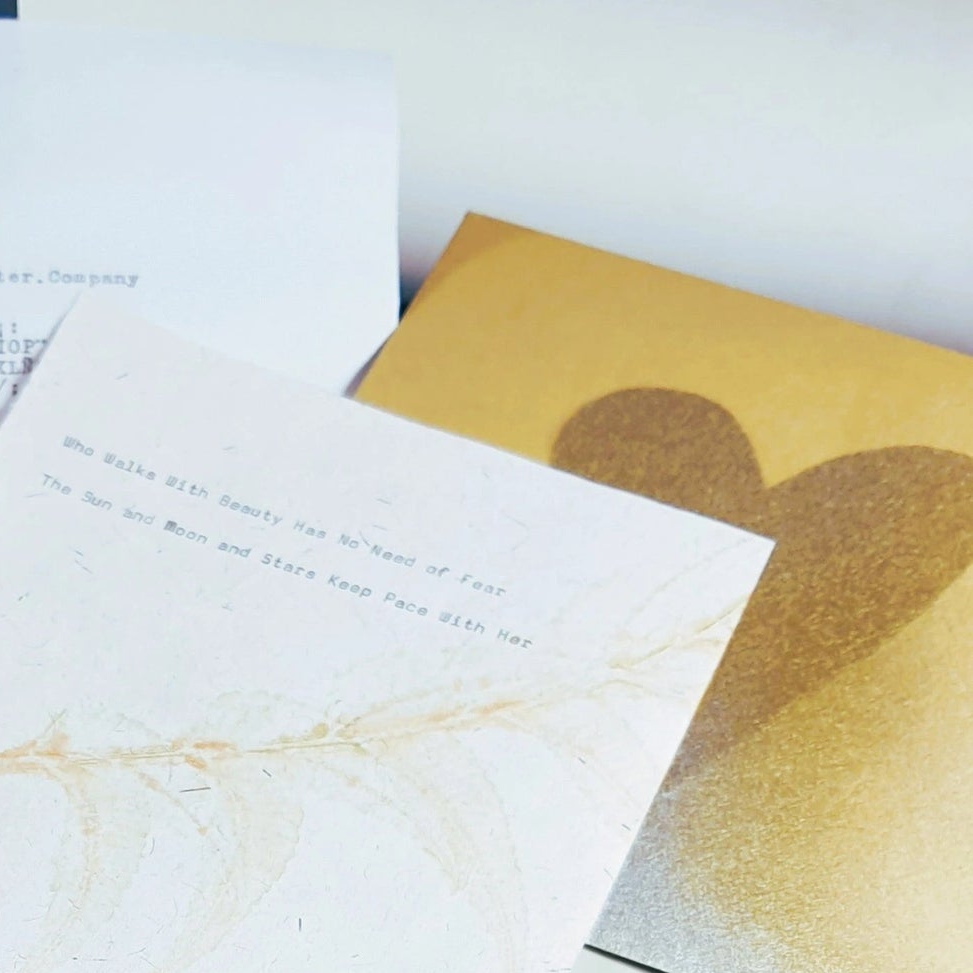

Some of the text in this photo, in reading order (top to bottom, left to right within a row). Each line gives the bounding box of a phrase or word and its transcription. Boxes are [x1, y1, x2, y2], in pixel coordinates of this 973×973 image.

[43, 473, 533, 650] The Sun and Moon and Stars Keep Pace With Her
[63, 435, 507, 598] Who Walks With Beauty Has No Need of Fear
